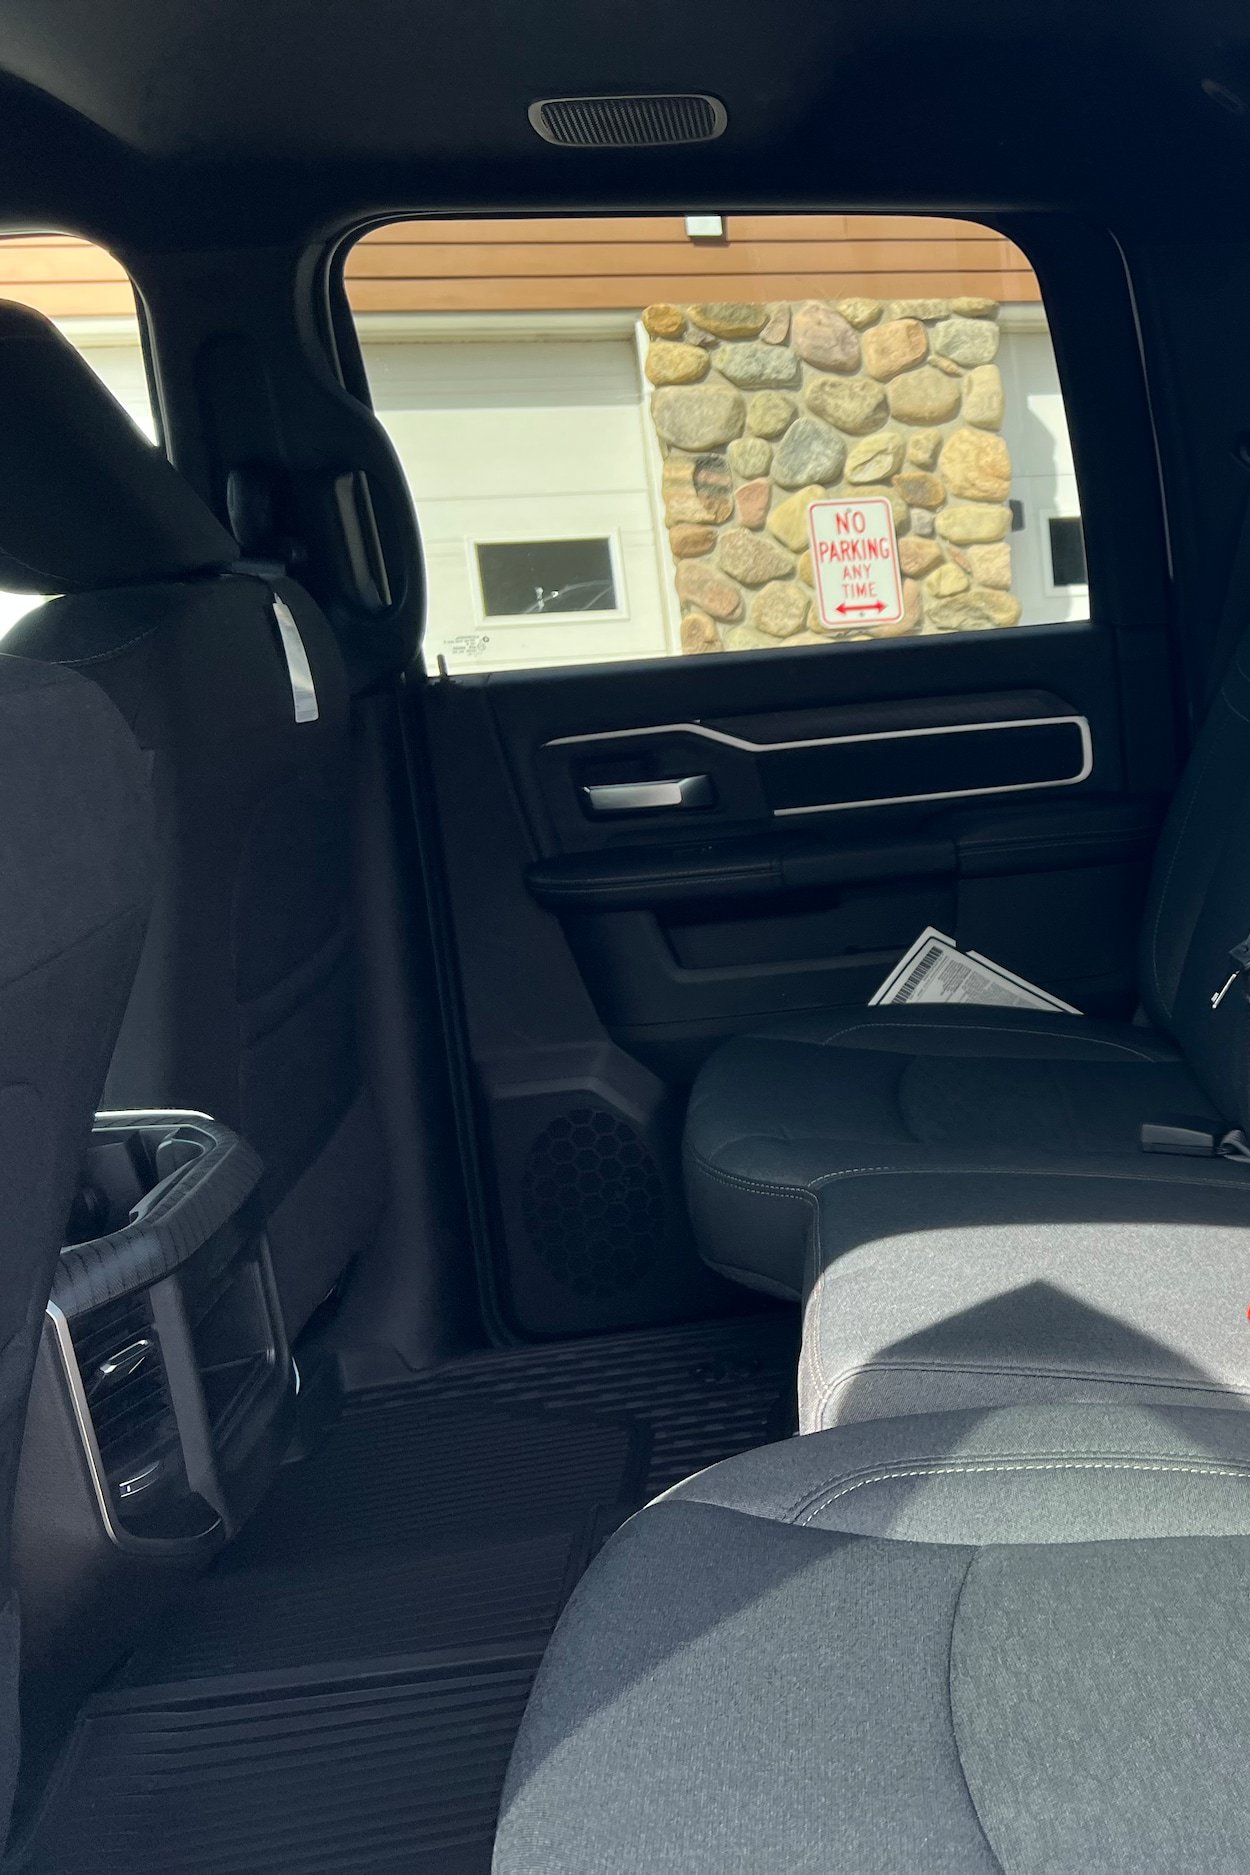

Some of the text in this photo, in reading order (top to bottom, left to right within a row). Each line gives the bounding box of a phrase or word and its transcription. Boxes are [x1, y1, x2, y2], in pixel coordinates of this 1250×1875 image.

[836, 511, 866, 534] NO
[819, 538, 890, 562] PARKING
[843, 564, 871, 580] ANY
[843, 583, 877, 598] TIME
